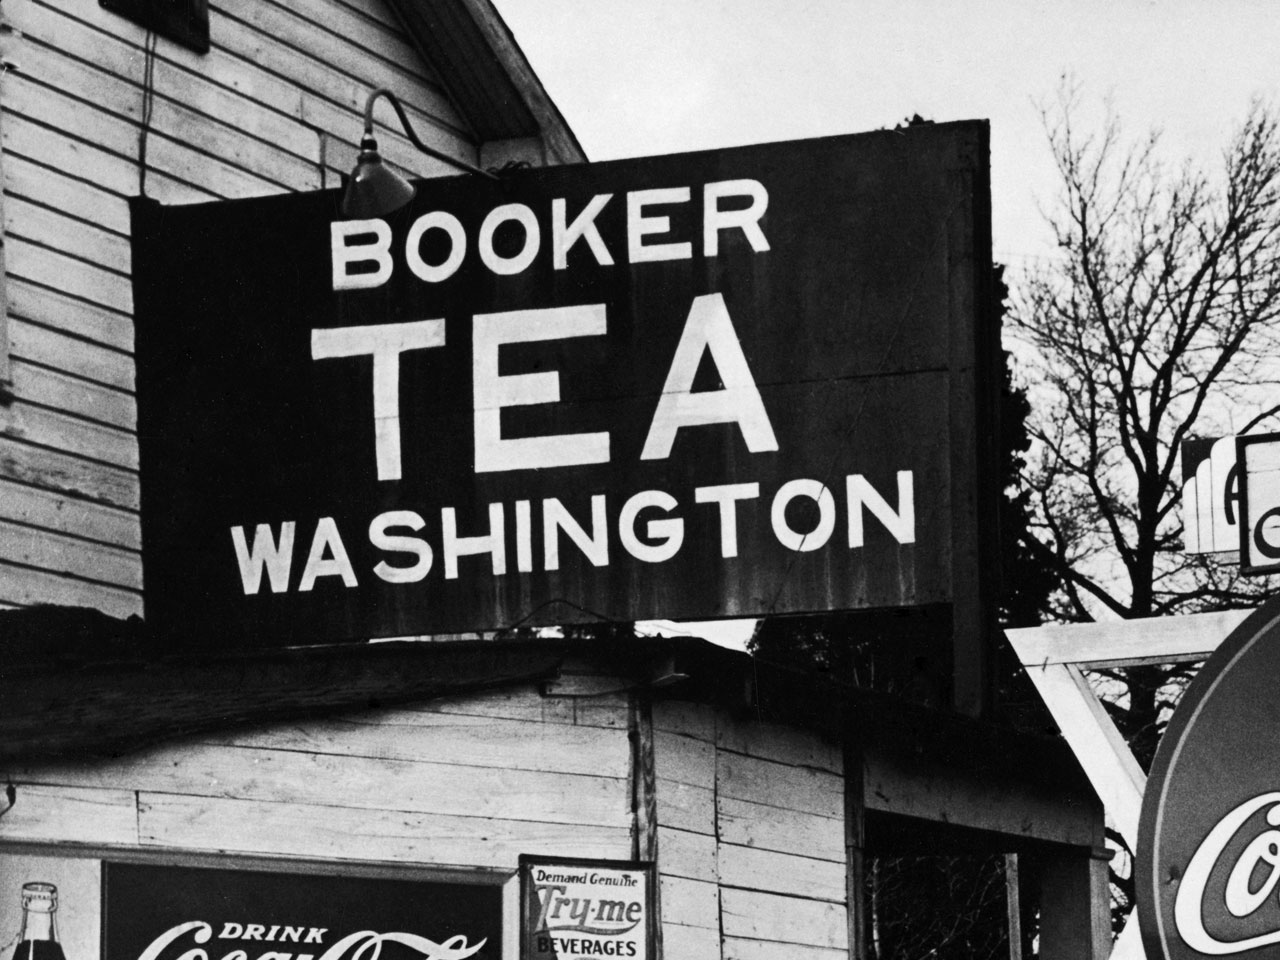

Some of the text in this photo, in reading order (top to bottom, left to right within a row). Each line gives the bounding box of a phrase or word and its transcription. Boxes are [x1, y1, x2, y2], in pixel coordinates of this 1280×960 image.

[331, 178, 771, 291] BOOKER
[311, 291, 779, 481] TEA
[230, 469, 916, 594] WASHINGTON
[536, 869, 587, 884] Demand
[218, 921, 328, 945] DRINK
[537, 936, 637, 957] BEVERAGES
